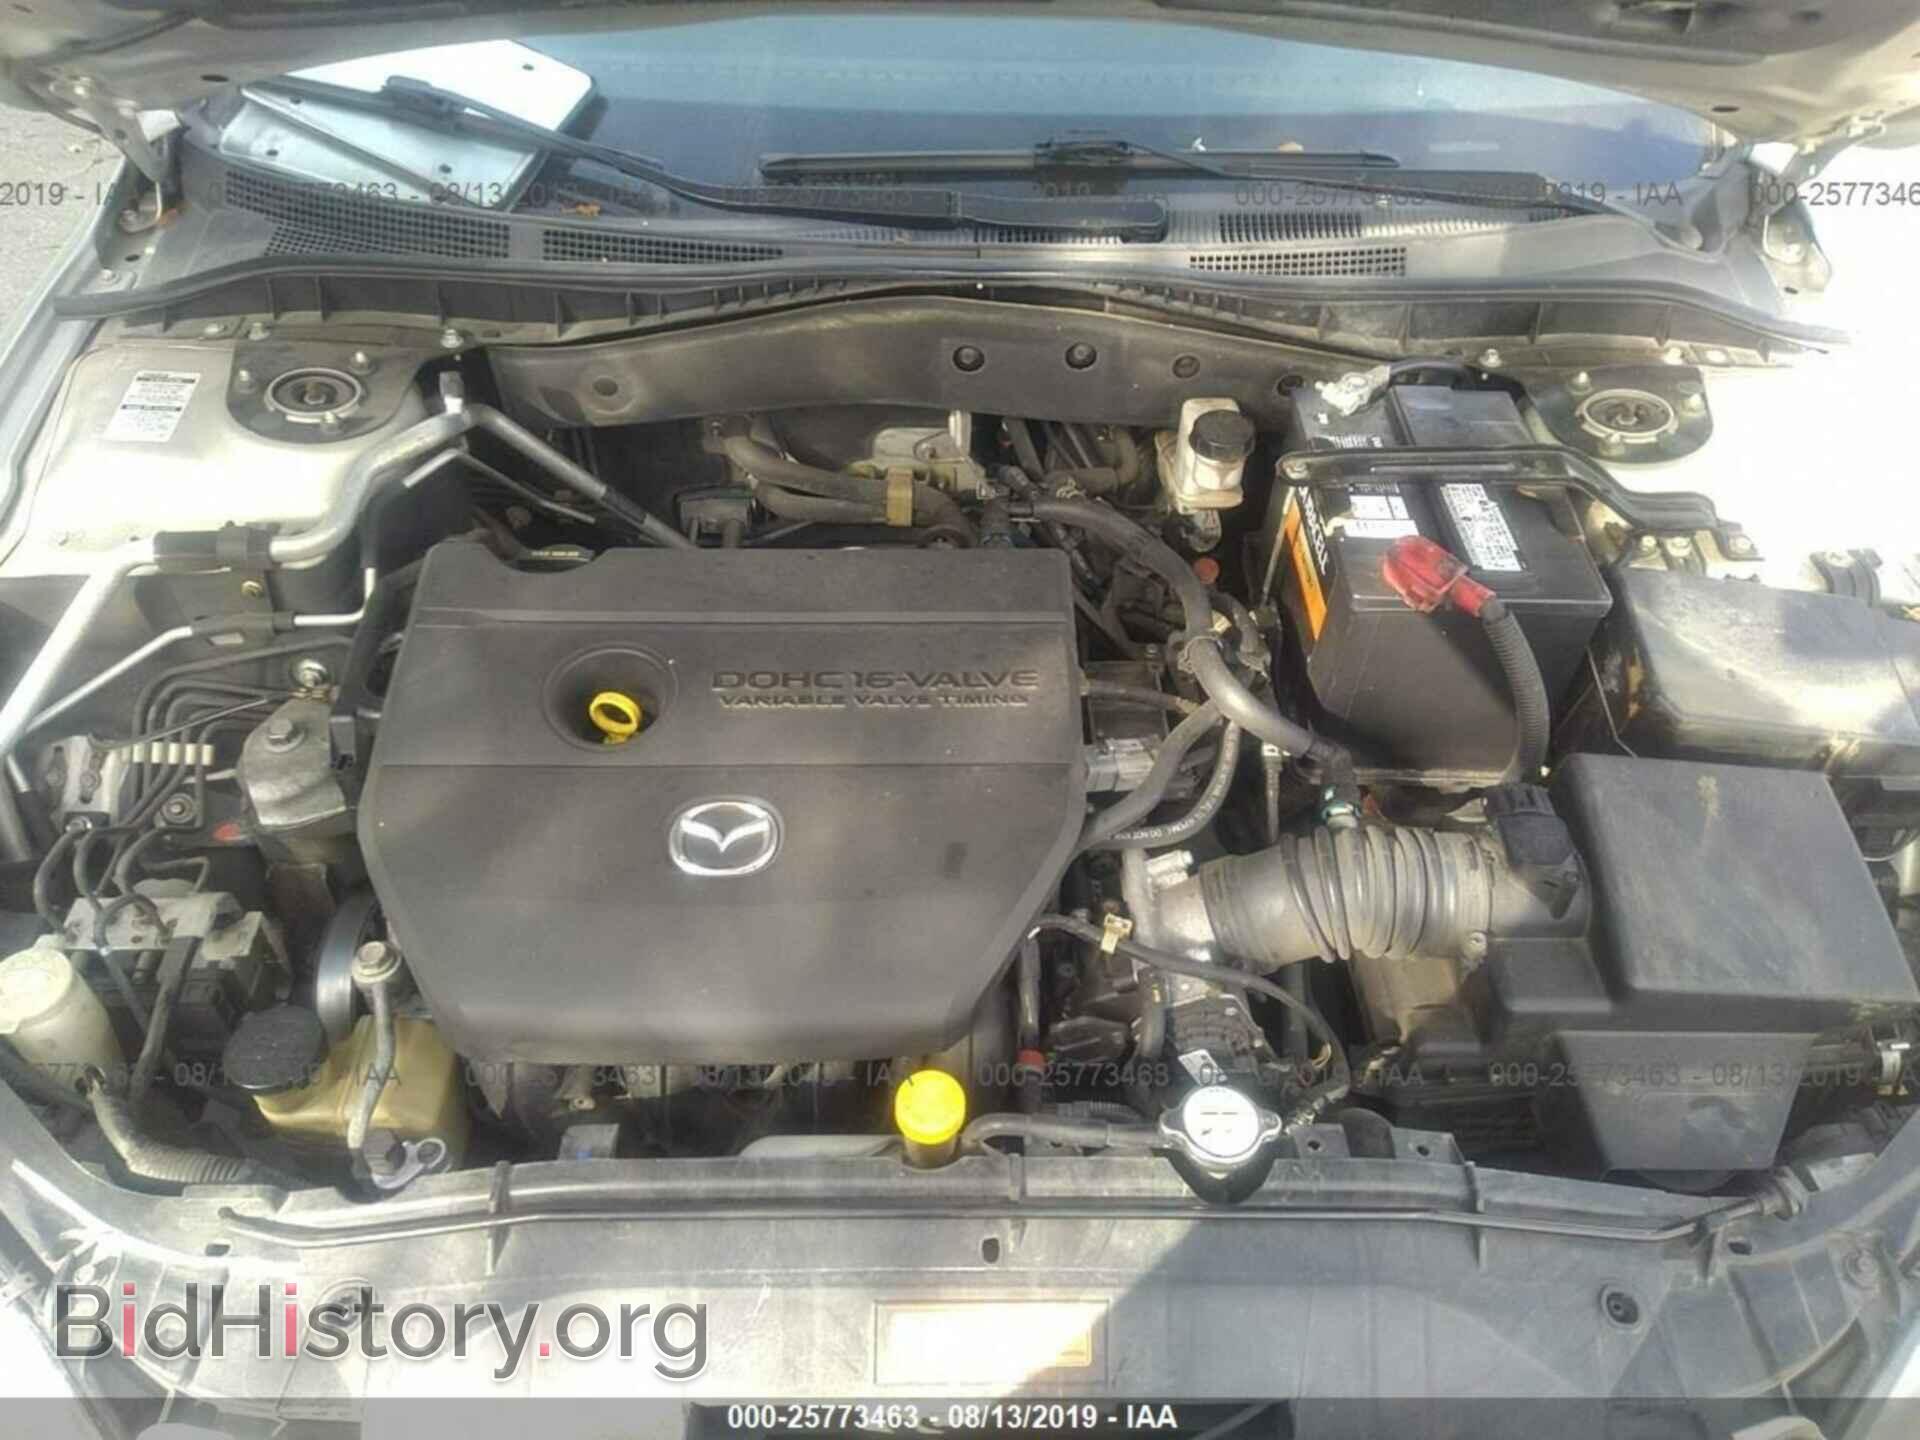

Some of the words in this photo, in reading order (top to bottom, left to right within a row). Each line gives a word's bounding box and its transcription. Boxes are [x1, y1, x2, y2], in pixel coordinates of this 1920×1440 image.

[712, 671, 843, 689] DOHC
[852, 671, 1038, 690] 16-VALVE
[852, 695, 932, 709] VALVE
